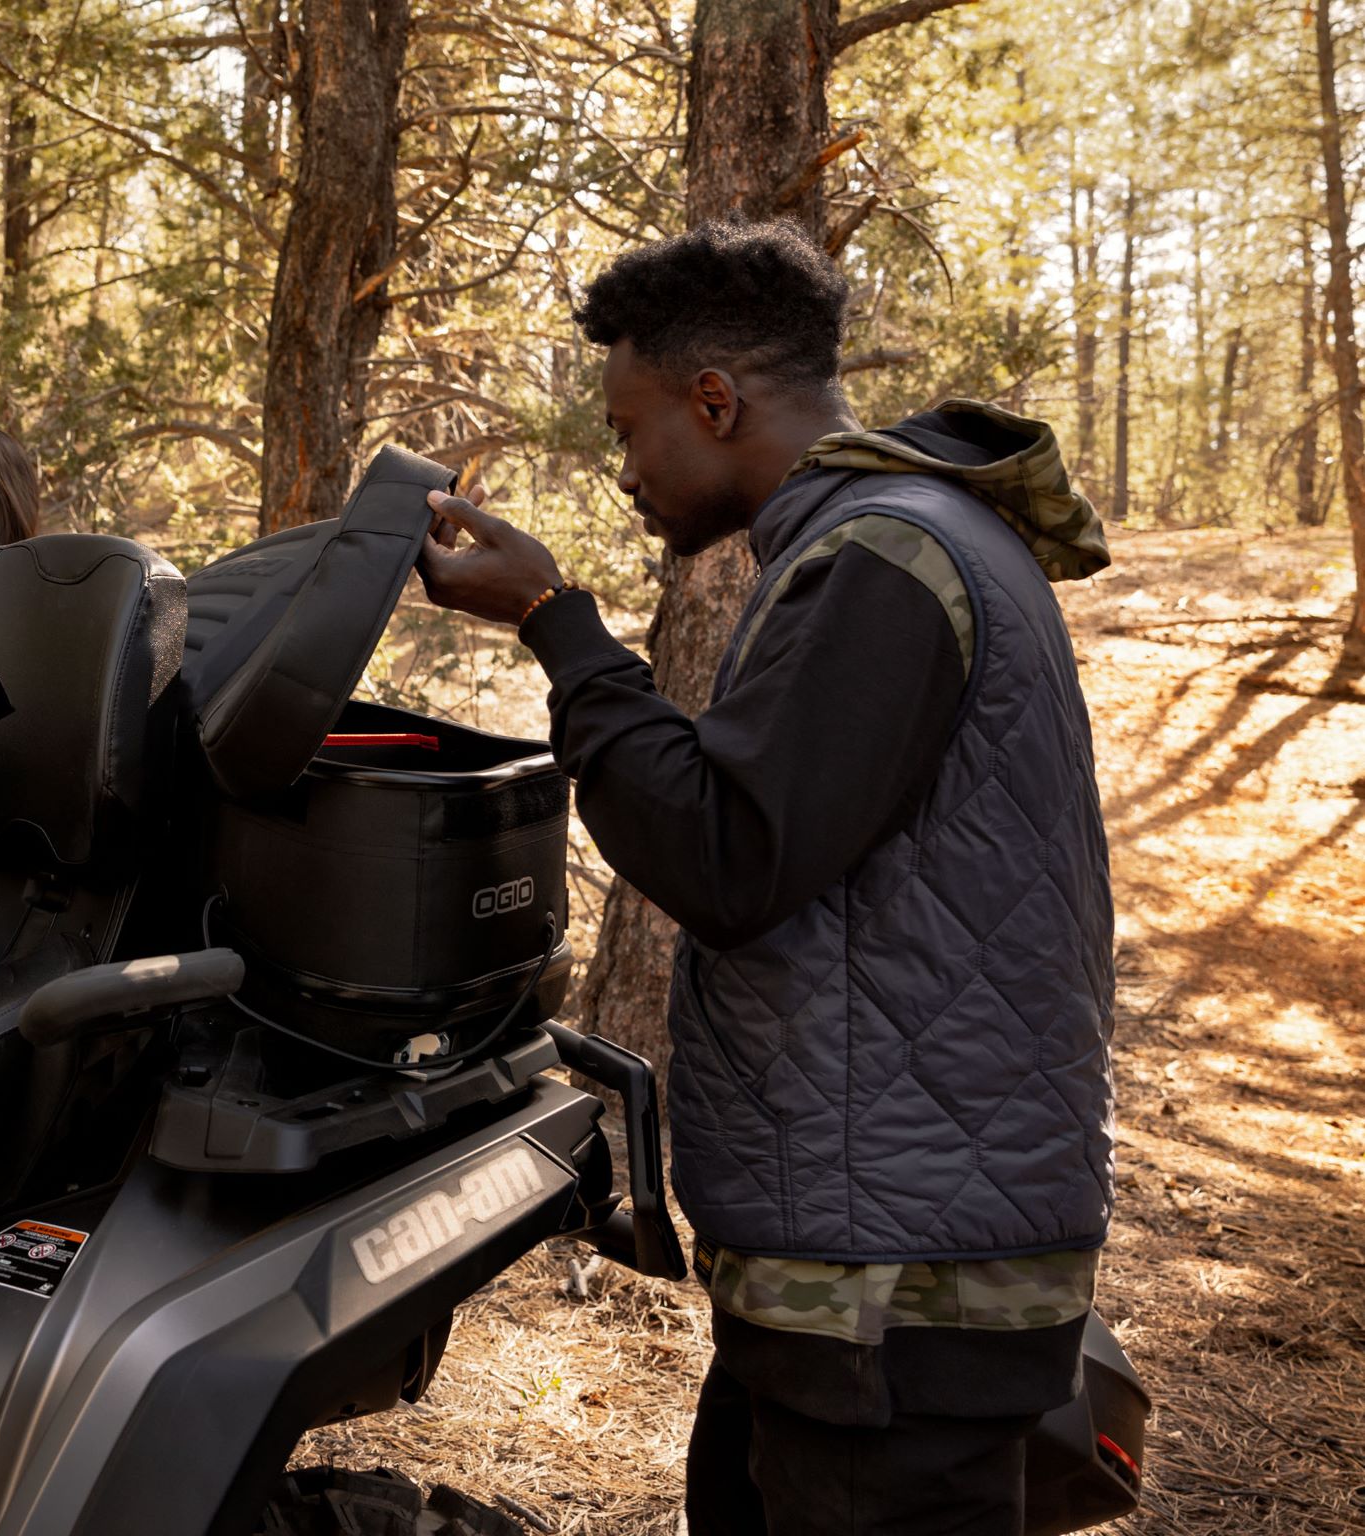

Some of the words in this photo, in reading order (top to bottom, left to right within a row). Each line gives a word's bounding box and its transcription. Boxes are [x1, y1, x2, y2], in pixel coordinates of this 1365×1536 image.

[473, 876, 534, 919] OGIO
[38, 1226, 72, 1238] WARNING
[351, 1148, 544, 1284] can-am
